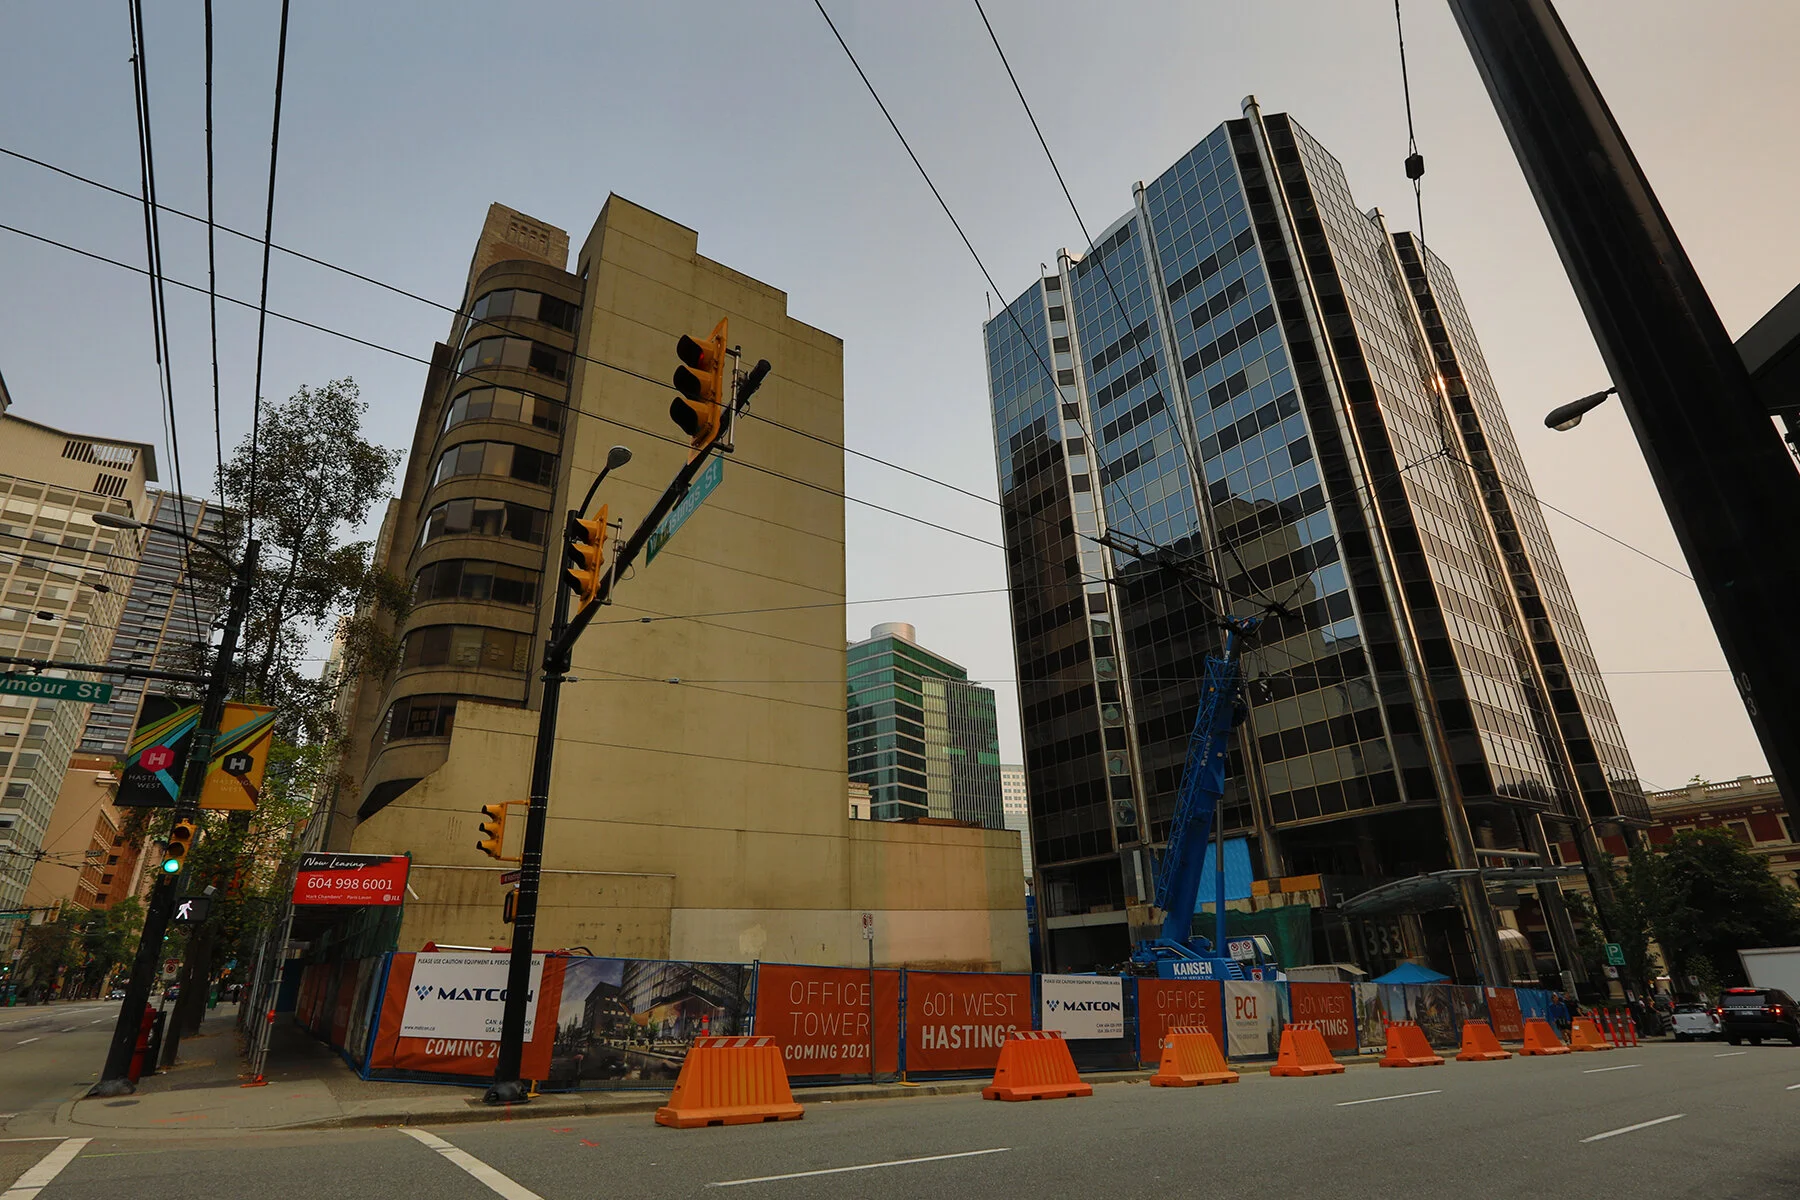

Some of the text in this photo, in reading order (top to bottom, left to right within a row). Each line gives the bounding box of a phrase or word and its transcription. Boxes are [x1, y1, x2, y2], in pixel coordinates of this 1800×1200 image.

[705, 463, 718, 489] St
[77, 683, 102, 699] St
[148, 753, 166, 766] H
[230, 758, 246, 770] H
[128, 774, 172, 783] HASTIN
[303, 855, 367, 872] Now Leasing
[307, 877, 393, 890] 604 998 6001
[1365, 925, 1403, 956] 333
[1172, 961, 1213, 976] KANSEN
[790, 981, 871, 1006] OFFICE
[1157, 990, 1206, 1009] OFFICE
[923, 992, 1018, 1017] 601 WEST
[1063, 1001, 1120, 1011] MATCON
[1234, 996, 1258, 1019] PCI
[1318, 996, 1345, 1014] WEST
[789, 1011, 870, 1036] TOWER
[425, 1038, 484, 1058] COMING
[785, 1043, 870, 1060] COMING 2021
